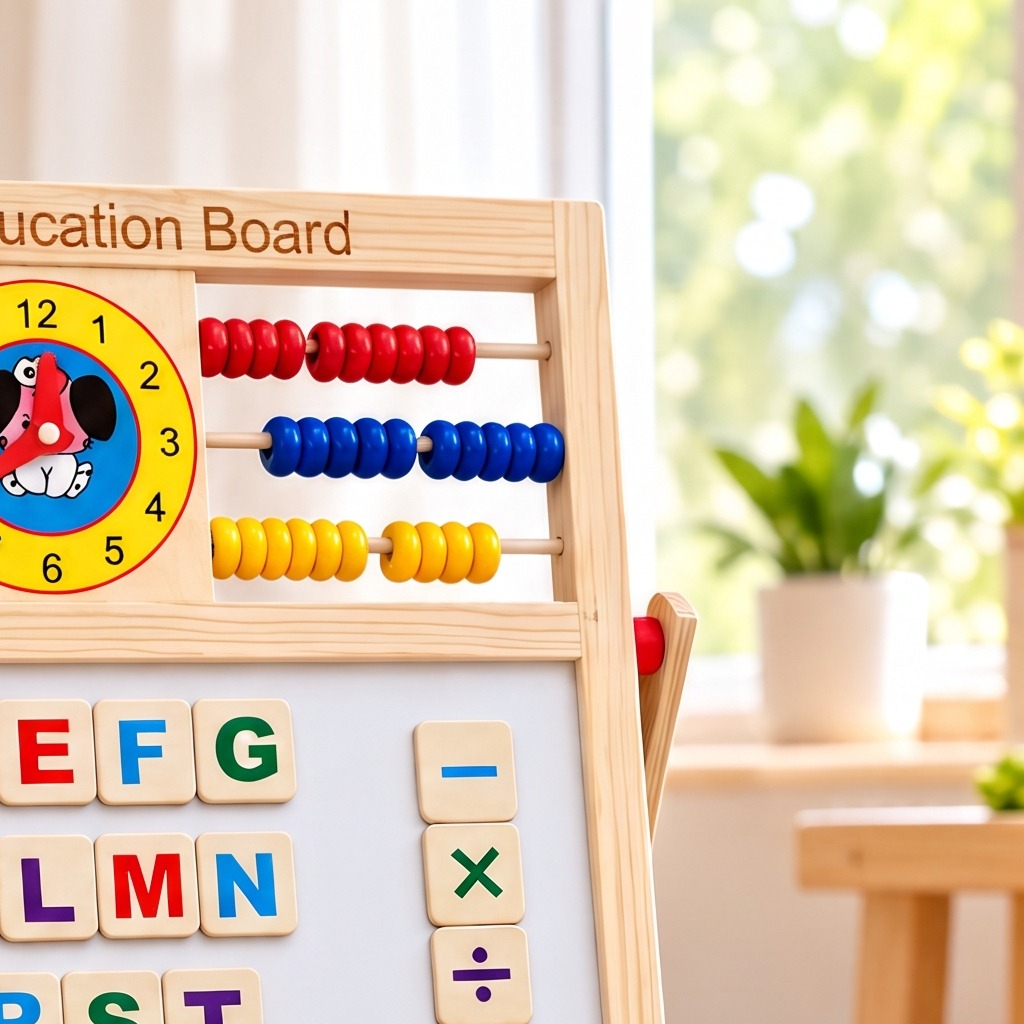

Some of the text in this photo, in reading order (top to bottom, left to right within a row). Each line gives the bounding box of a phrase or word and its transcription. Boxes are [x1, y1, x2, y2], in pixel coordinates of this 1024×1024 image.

[203, 206, 351, 255] Board
[18, 299, 57, 328] 12
[93, 315, 104, 343] 1
[141, 361, 159, 389] 2
[161, 428, 179, 456] 3
[145, 492, 165, 521] 4
[105, 536, 123, 565] 5
[43, 553, 62, 583] 6
[18, 719, 74, 784] E
[119, 720, 166, 784] F
[215, 717, 278, 782] G
[21, 858, 75, 922] L
[113, 854, 183, 918] M
[216, 853, 277, 918] N
[453, 947, 511, 1002] ÷
